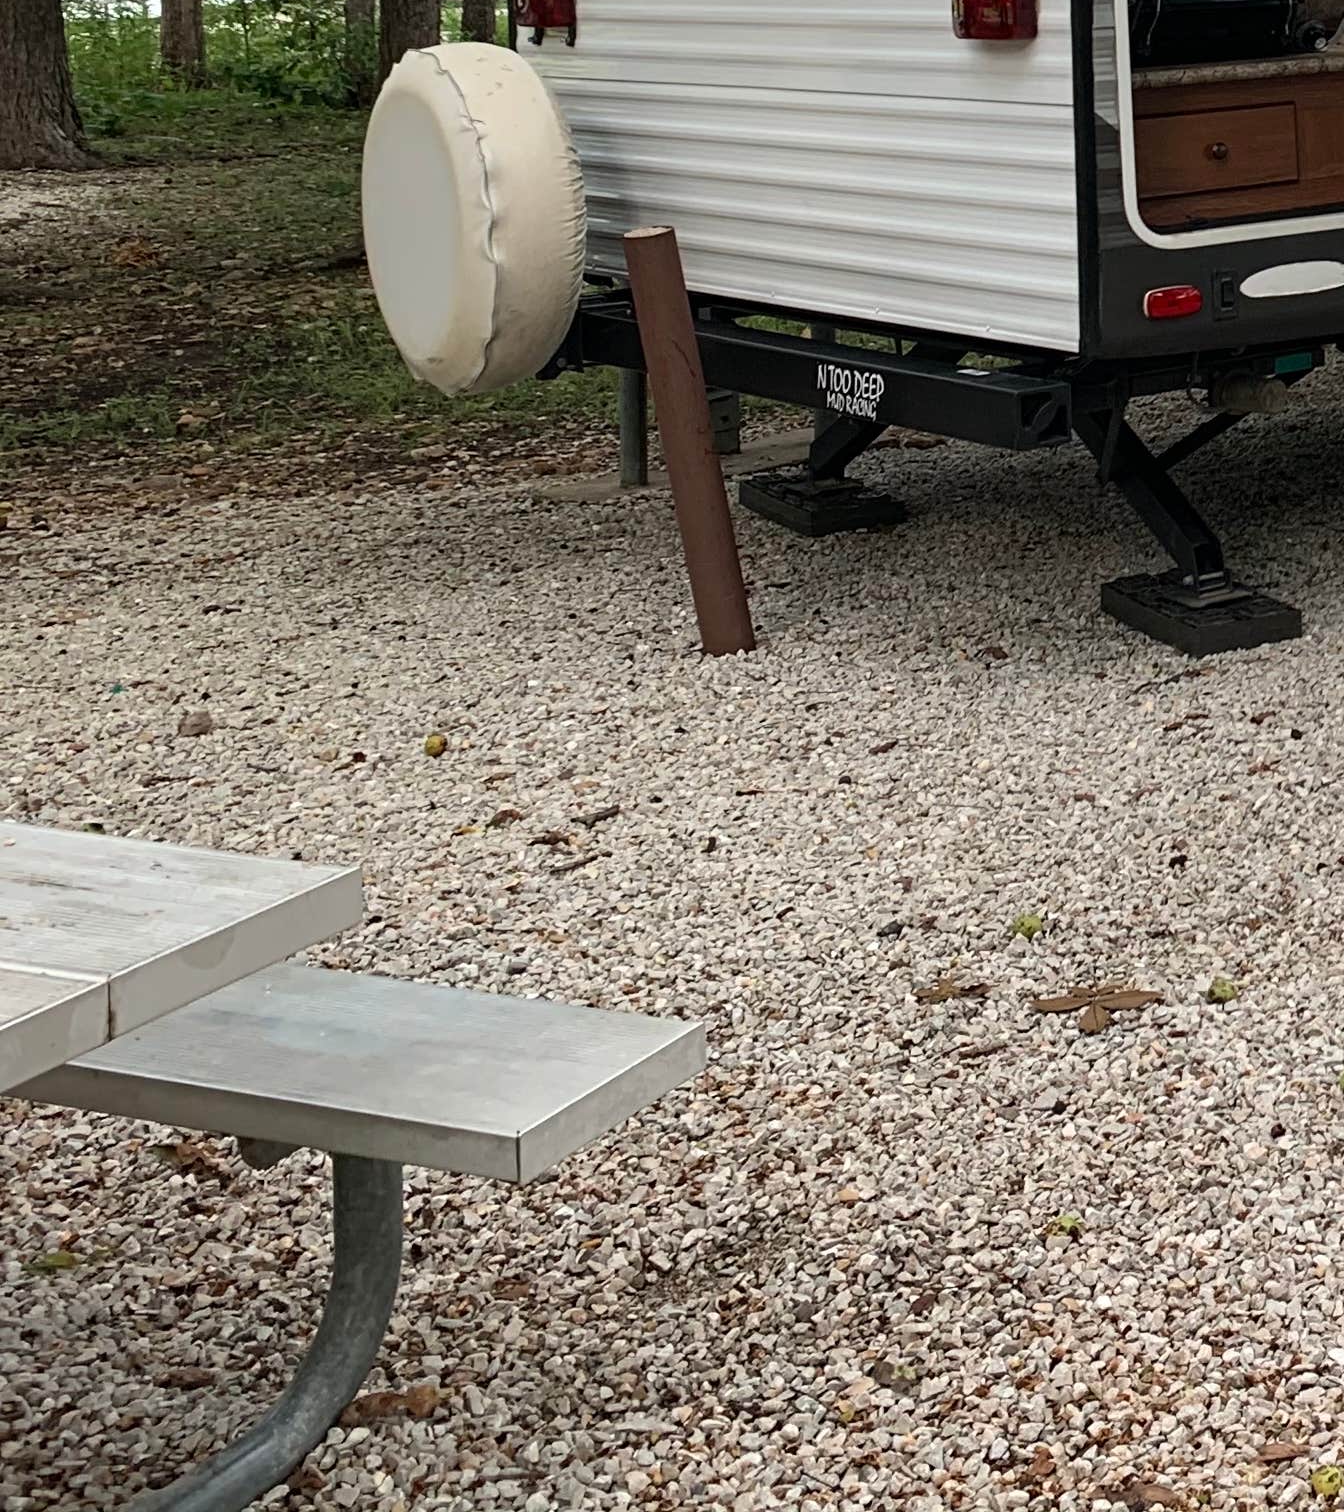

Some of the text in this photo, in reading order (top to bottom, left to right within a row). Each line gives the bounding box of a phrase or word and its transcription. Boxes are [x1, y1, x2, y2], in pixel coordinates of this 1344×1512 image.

[828, 365, 851, 394] TOO
[854, 370, 884, 402] DEEP
[826, 391, 877, 422] MUD RACING
